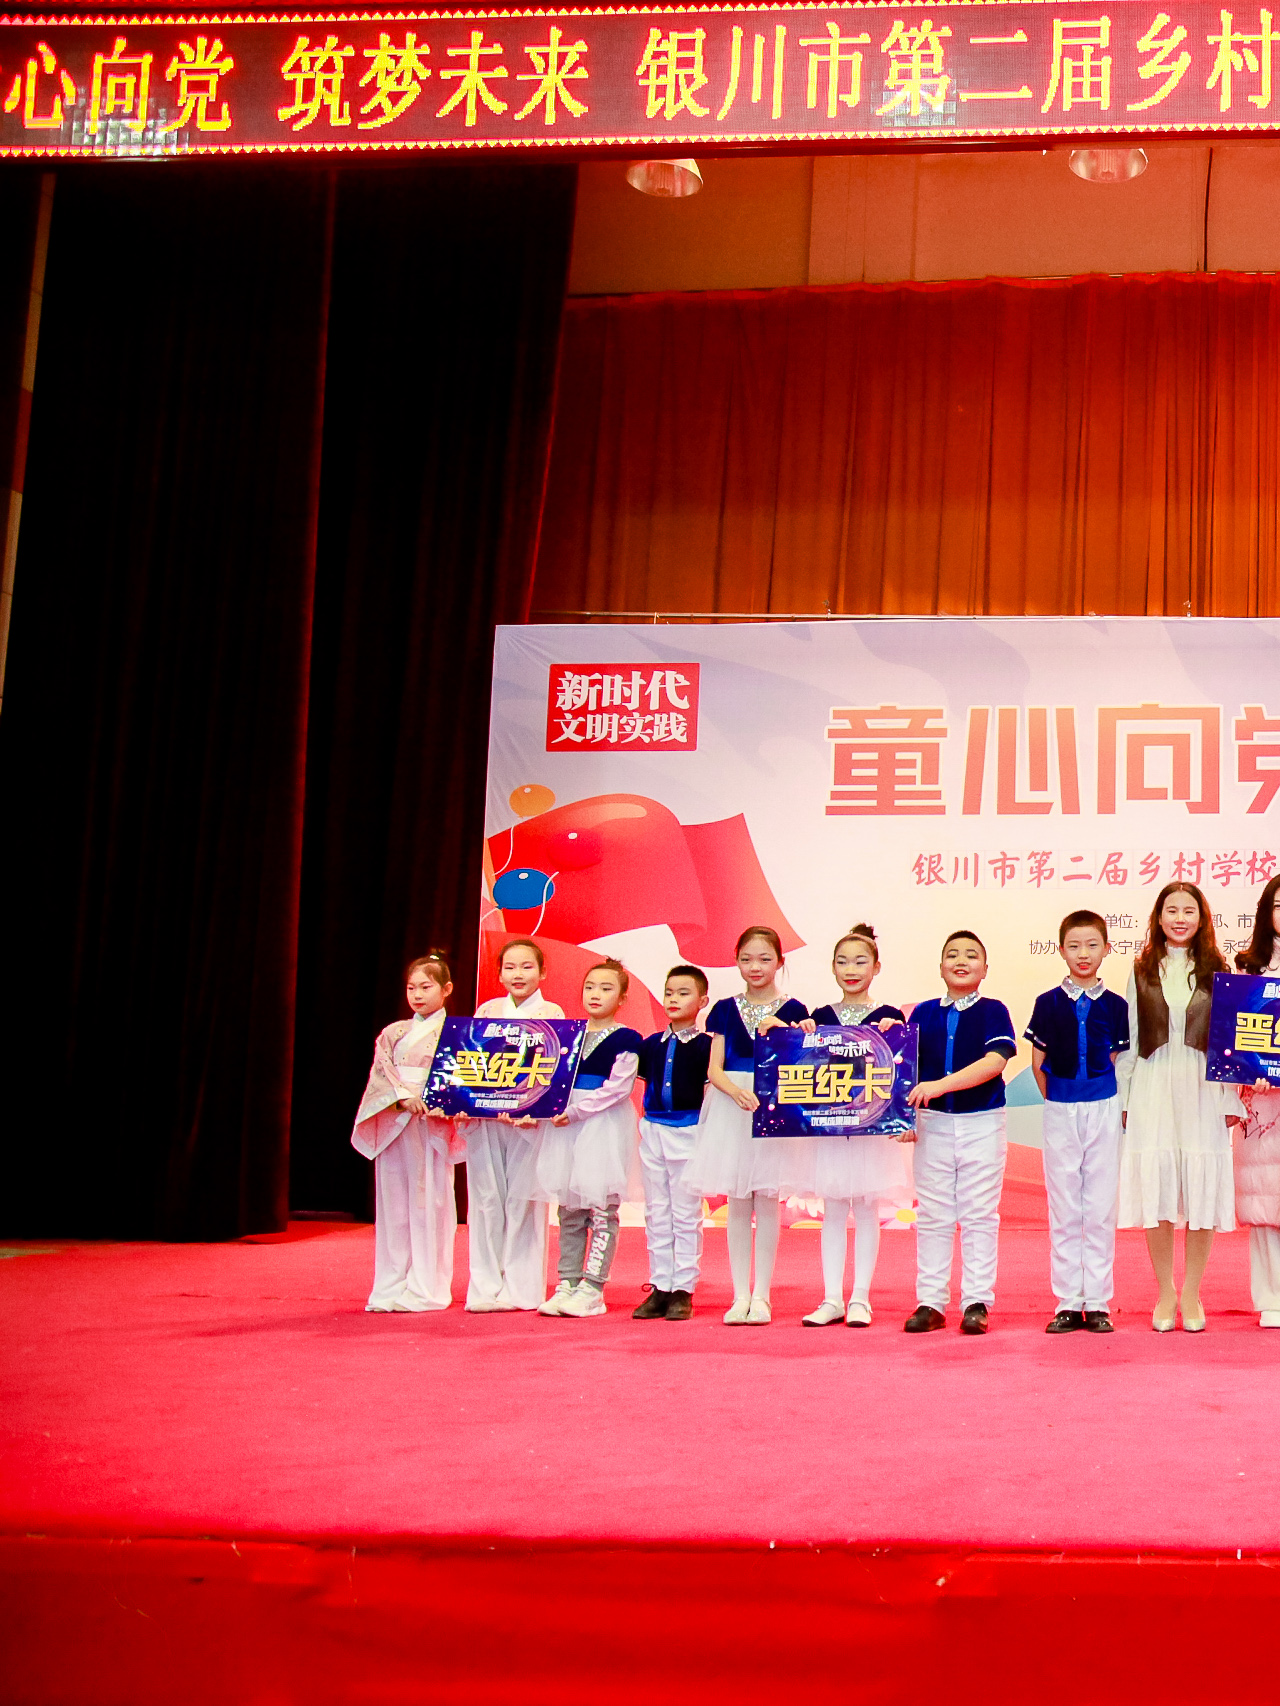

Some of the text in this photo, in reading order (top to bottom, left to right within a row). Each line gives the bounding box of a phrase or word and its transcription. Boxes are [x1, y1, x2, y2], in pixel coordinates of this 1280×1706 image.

[4, 37, 234, 132] 心向党
[278, 27, 589, 130] 筑梦未来
[555, 670, 691, 711] 新时代
[550, 712, 688, 744] 文明实践
[450, 1050, 556, 1088] 晋级卡
[778, 1063, 892, 1104] 晋级卡
